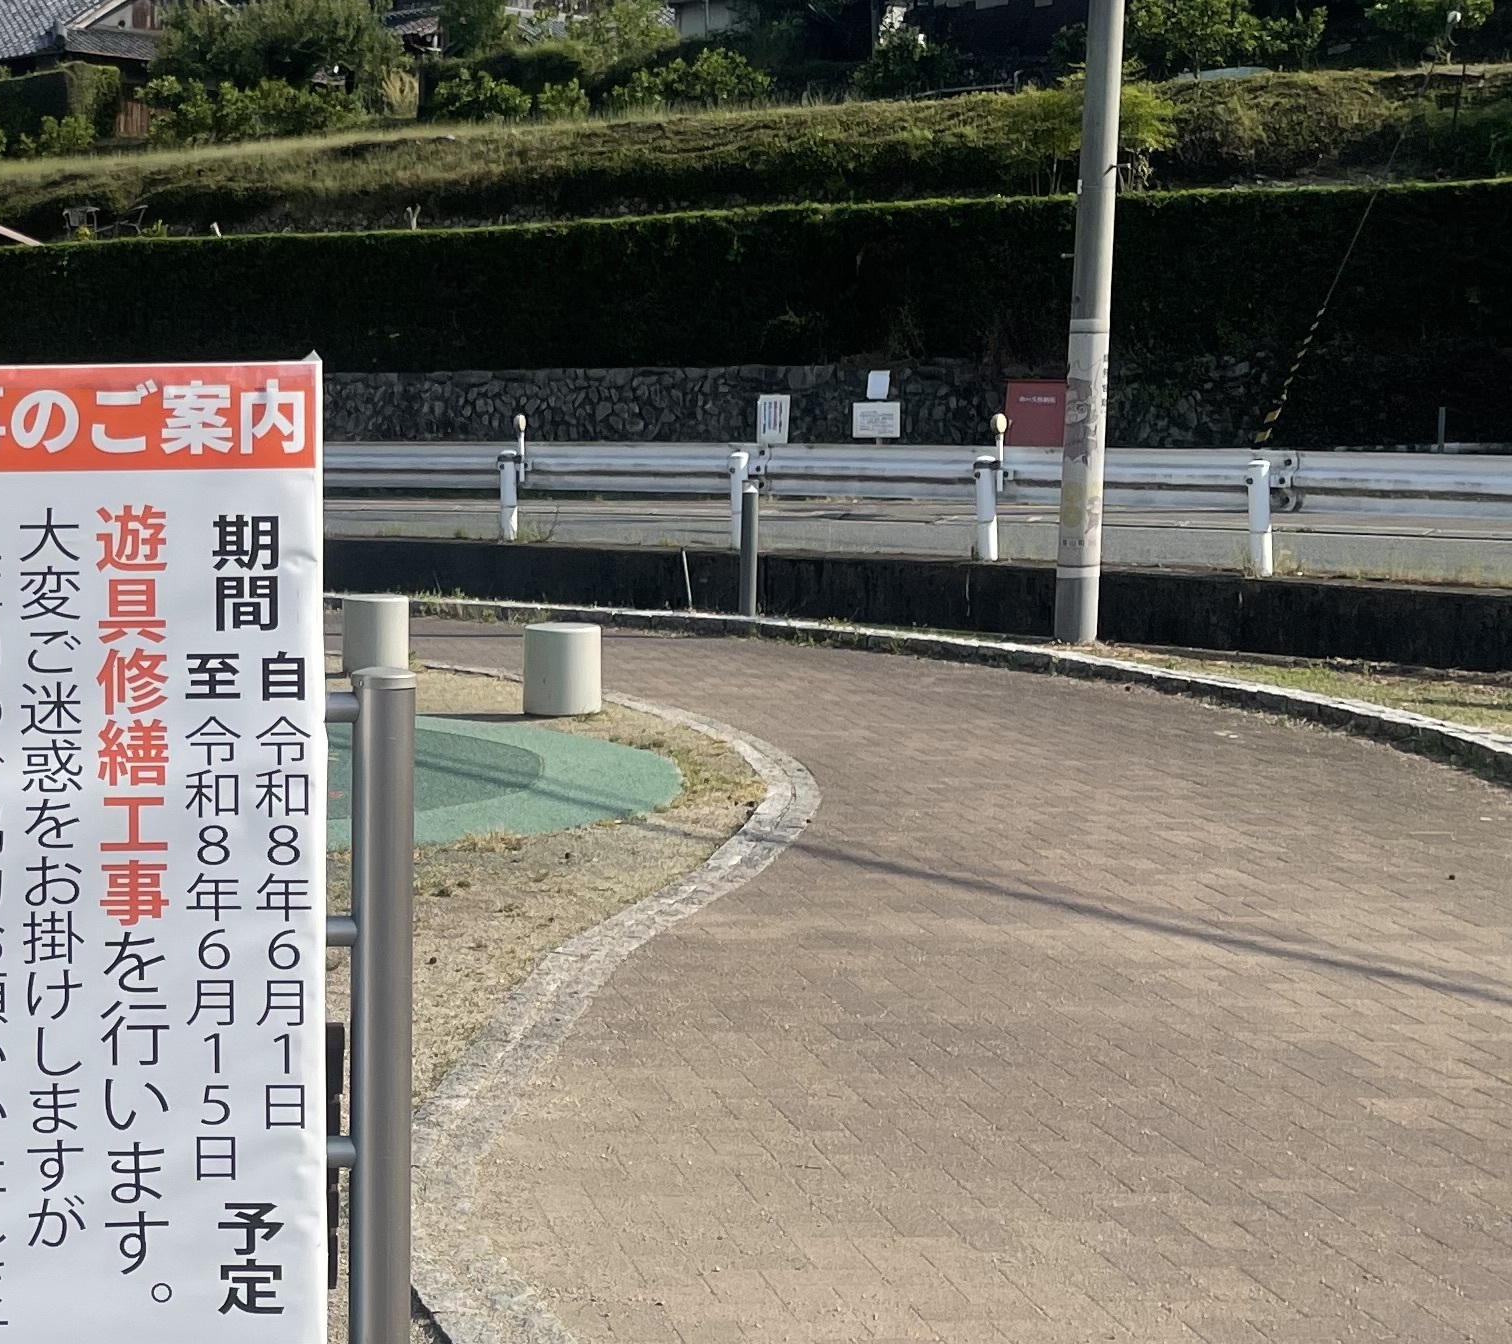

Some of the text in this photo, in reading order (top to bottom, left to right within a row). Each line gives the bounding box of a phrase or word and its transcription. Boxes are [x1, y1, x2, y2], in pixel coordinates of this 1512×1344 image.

[212, 515, 279, 631] 期間
[20, 508, 85, 1247] 大変ご迷惑をお掛けしますが
[96, 505, 172, 1302] 遊具修繕工事を行います。
[218, 1203, 284, 1314] 予定
